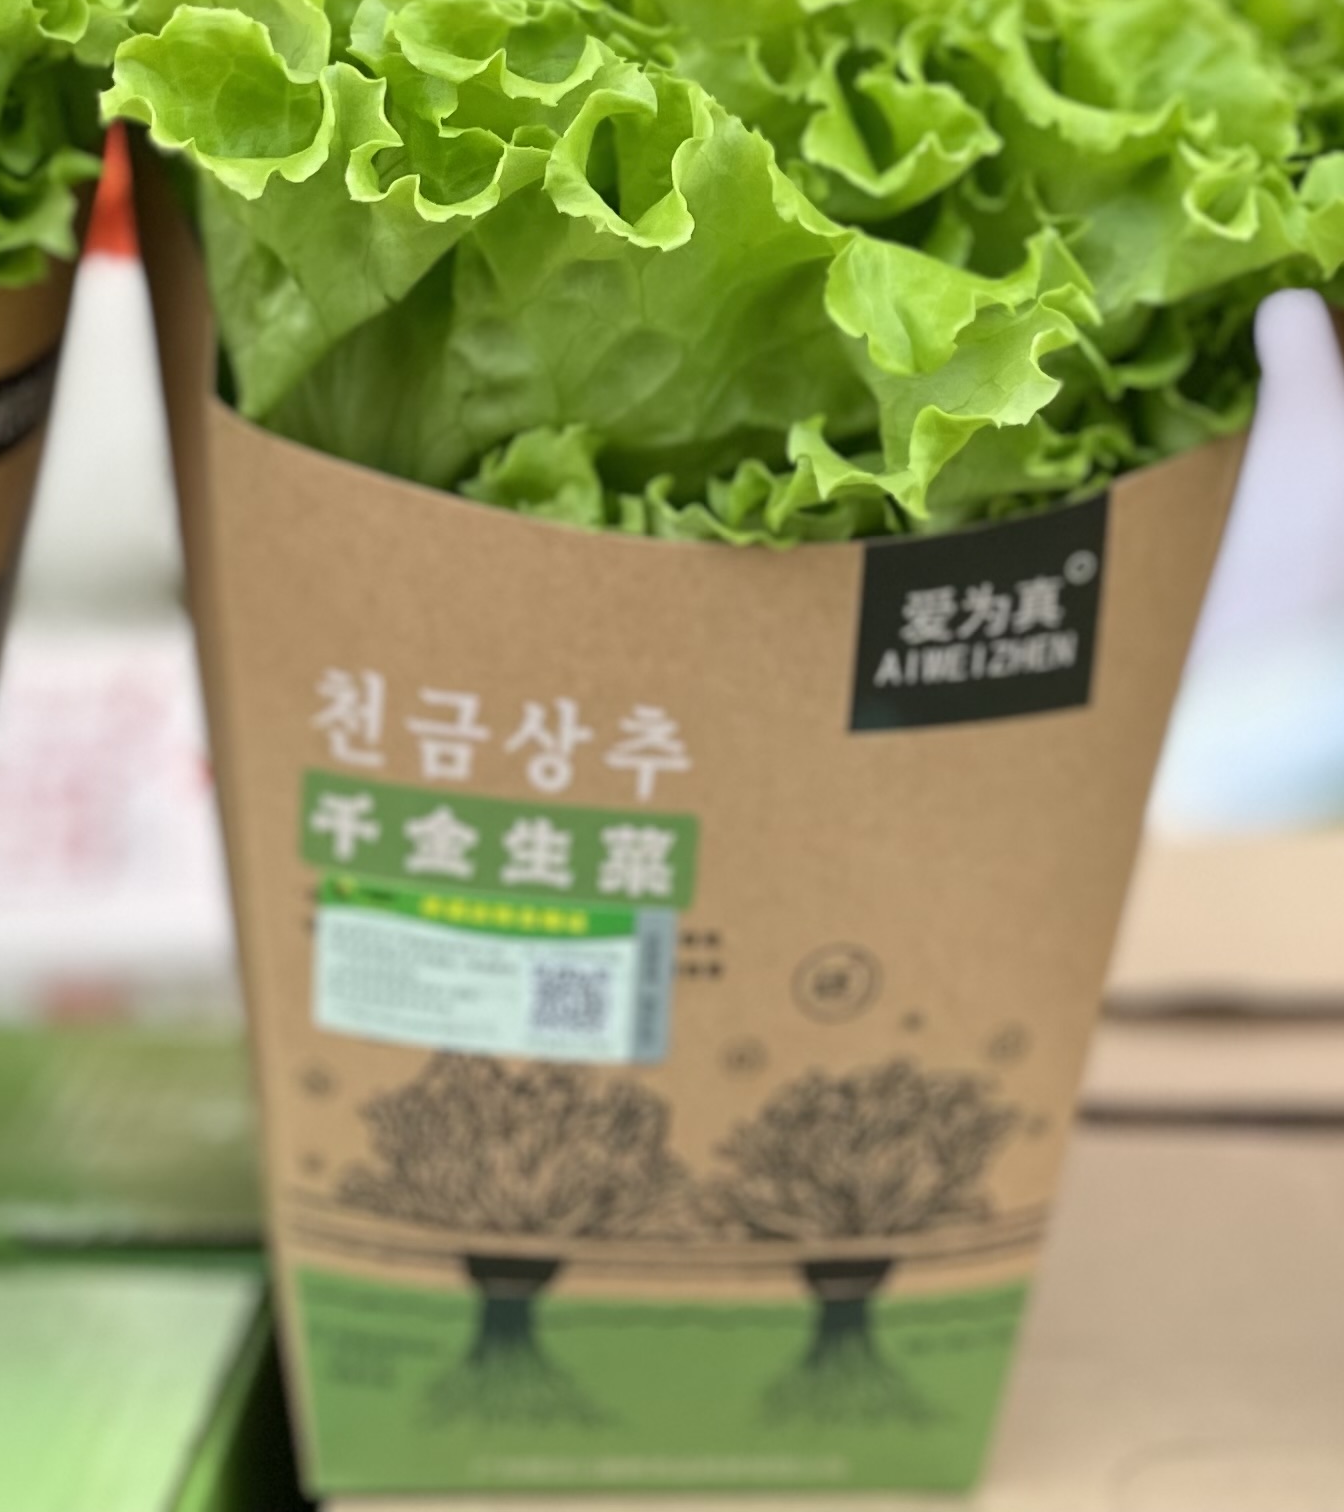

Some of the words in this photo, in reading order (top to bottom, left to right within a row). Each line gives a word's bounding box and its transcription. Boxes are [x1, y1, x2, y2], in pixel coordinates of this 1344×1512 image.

[900, 575, 1067, 644] 爱为真
[873, 630, 1078, 687] AIWEIZHEN
[311, 668, 693, 800] 천금상추
[311, 792, 677, 897] 千金生菜
